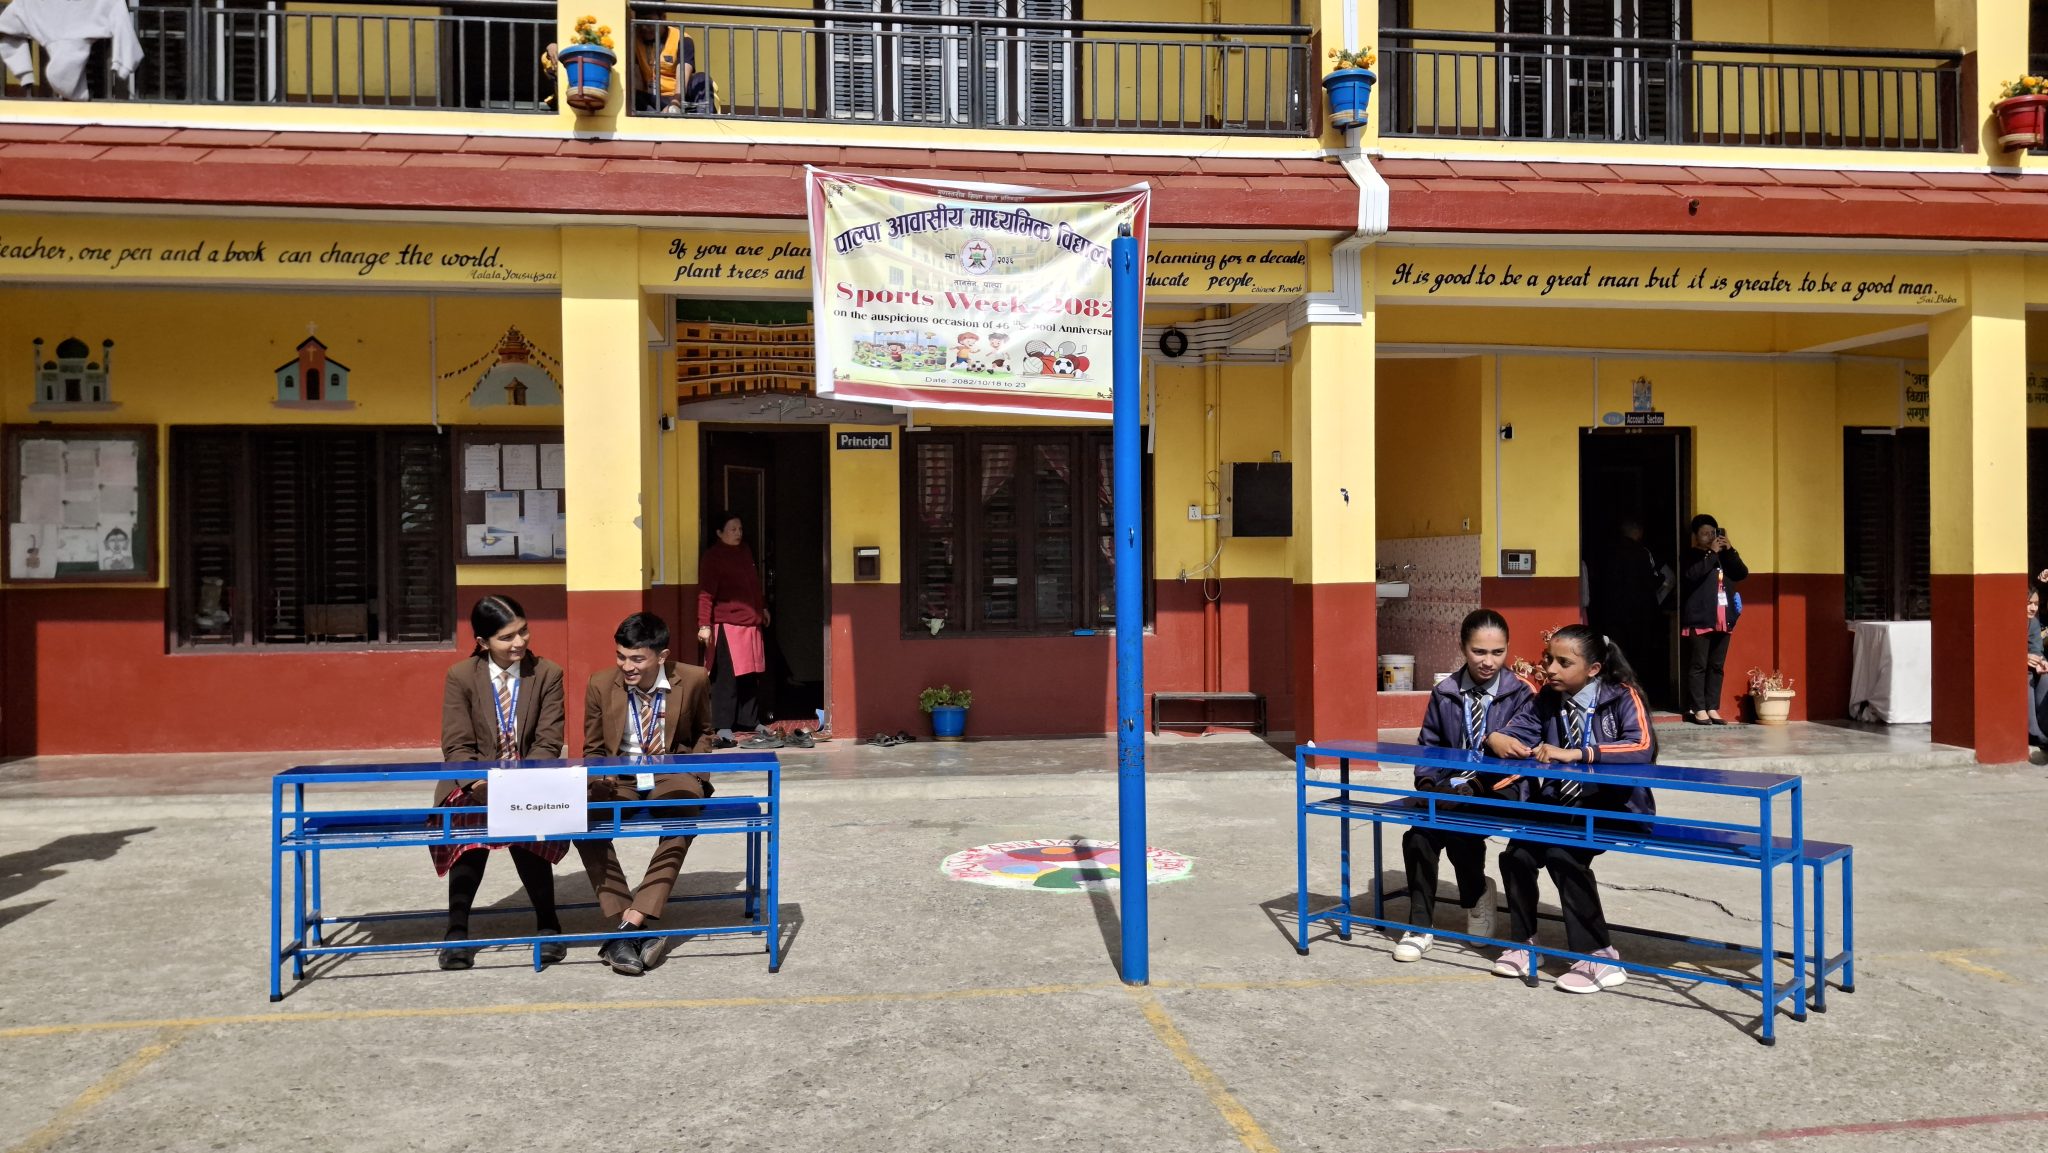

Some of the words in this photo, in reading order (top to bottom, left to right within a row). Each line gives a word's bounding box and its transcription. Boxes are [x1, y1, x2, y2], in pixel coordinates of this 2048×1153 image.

[834, 222, 881, 254] पाल्पा
[886, 203, 964, 238] आवासीय
[970, 207, 1053, 241] माध्यमिक
[1057, 221, 1112, 269] विद्याल
[0, 235, 73, 262] eacher,
[79, 245, 111, 262] one
[110, 246, 152, 269] pen
[160, 240, 205, 262] and
[208, 248, 219, 263] a
[222, 240, 267, 263] book
[278, 248, 312, 264] can
[320, 241, 390, 276] change
[395, 243, 433, 266] the
[441, 246, 504, 268] world.
[669, 238, 688, 260] If
[694, 243, 727, 260] you
[735, 244, 764, 256] are
[768, 241, 811, 262] plan
[1219, 254, 1243, 270] for
[1246, 254, 1257, 265] a
[673, 262, 723, 281] plant
[727, 263, 769, 279] trees
[774, 265, 806, 280] and
[1145, 271, 1190, 287] ducate
[1207, 271, 1256, 292] people.
[1392, 263, 1415, 285] It
[1413, 267, 1430, 284] is
[1429, 263, 1477, 294] good
[1476, 264, 1496, 286] to
[1500, 264, 1523, 286] be
[1526, 274, 1538, 287] a
[1541, 265, 1592, 295] great
[1598, 274, 1640, 288] man
[1645, 266, 1681, 289] but
[1687, 267, 1708, 289] it
[1710, 272, 1728, 290] is
[1729, 270, 1792, 298] greater
[1797, 271, 1817, 293] to
[1817, 272, 1838, 293] be
[1841, 280, 1853, 292] a
[1852, 274, 1897, 302] good
[1899, 282, 1939, 295] man.
[836, 282, 935, 308] Sports
[833, 309, 847, 317] on
[850, 310, 868, 321] the
[871, 313, 929, 324] auspicious
[932, 317, 979, 328] occasion
[982, 320, 993, 329] of
[1058, 324, 1112, 336] Anniversar
[925, 376, 949, 384] Date:
[952, 378, 1002, 387] 2082/10/18
[840, 434, 889, 449] Principal
[510, 804, 523, 812] St.
[525, 802, 570, 812] Capitanio
